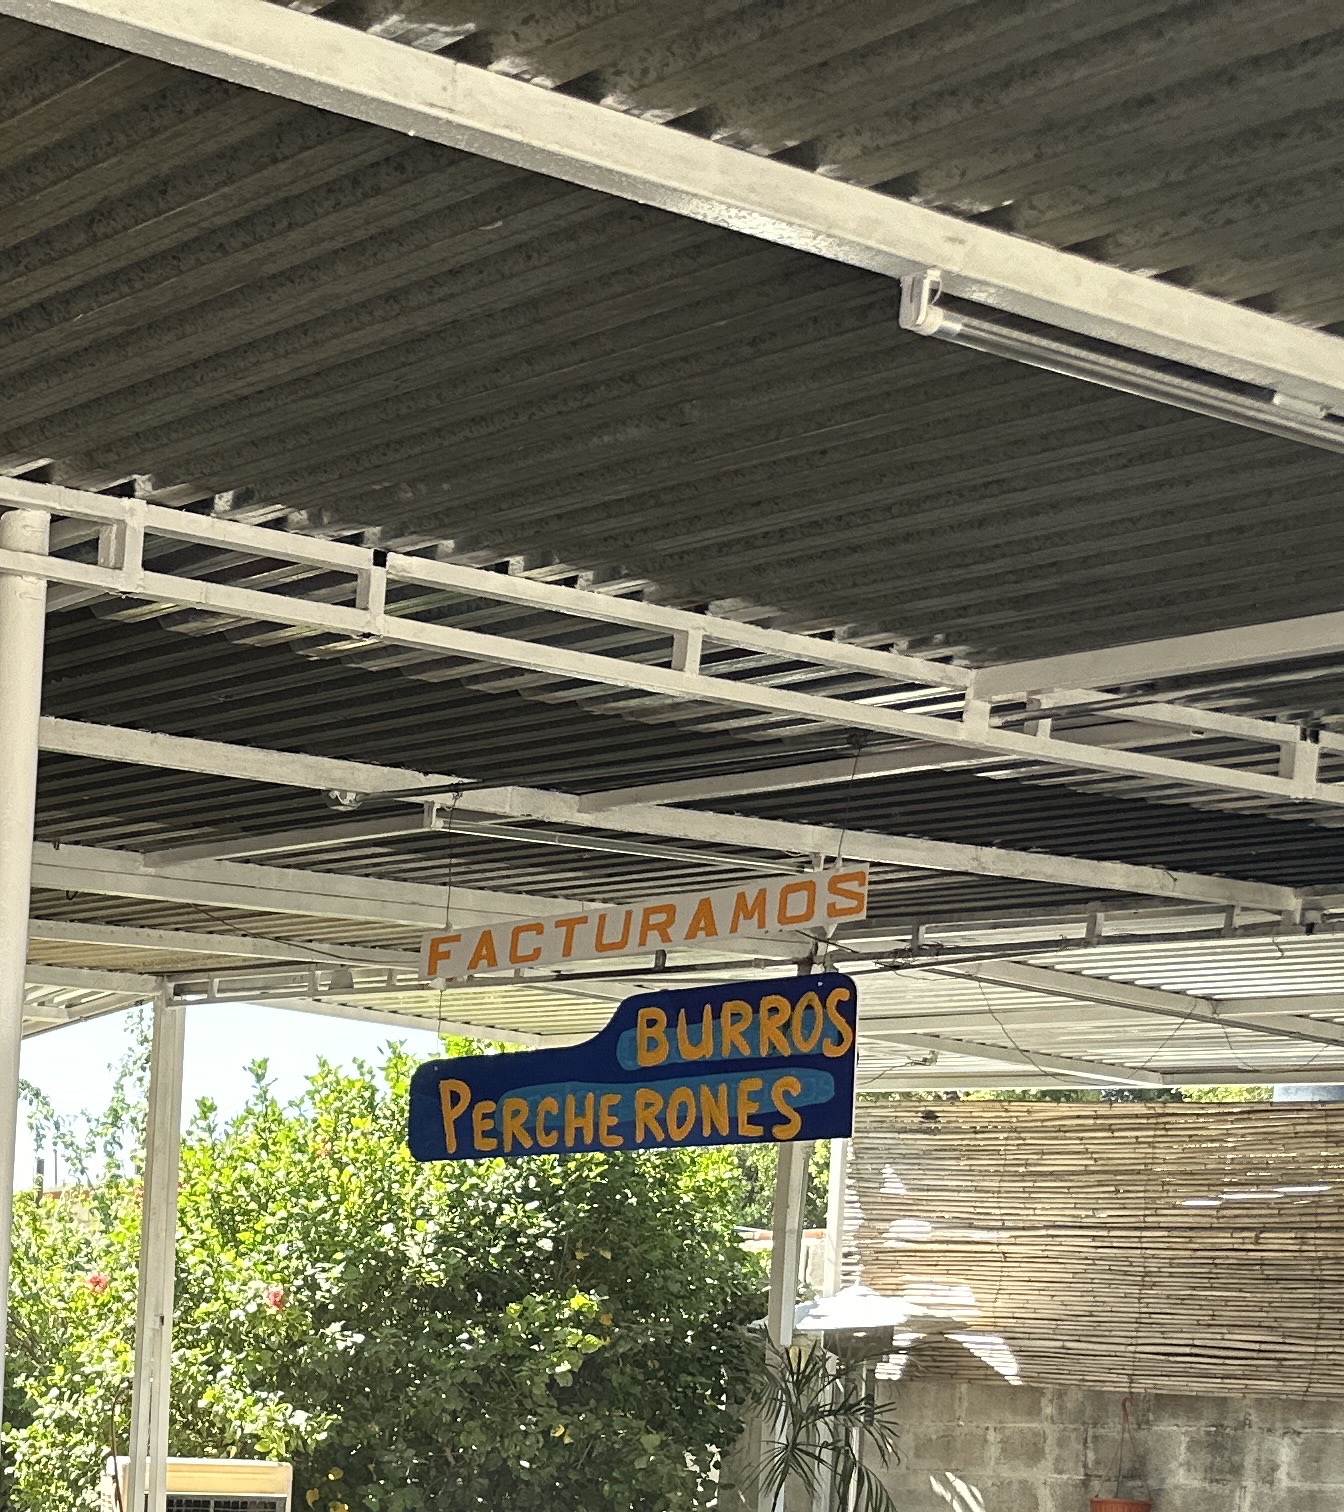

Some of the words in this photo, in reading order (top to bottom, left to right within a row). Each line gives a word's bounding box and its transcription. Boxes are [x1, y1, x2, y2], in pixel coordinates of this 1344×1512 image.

[427, 870, 868, 976] FACTURAMOS
[636, 987, 854, 1068] BURROS
[438, 1075, 802, 1155] PERCHERONES
